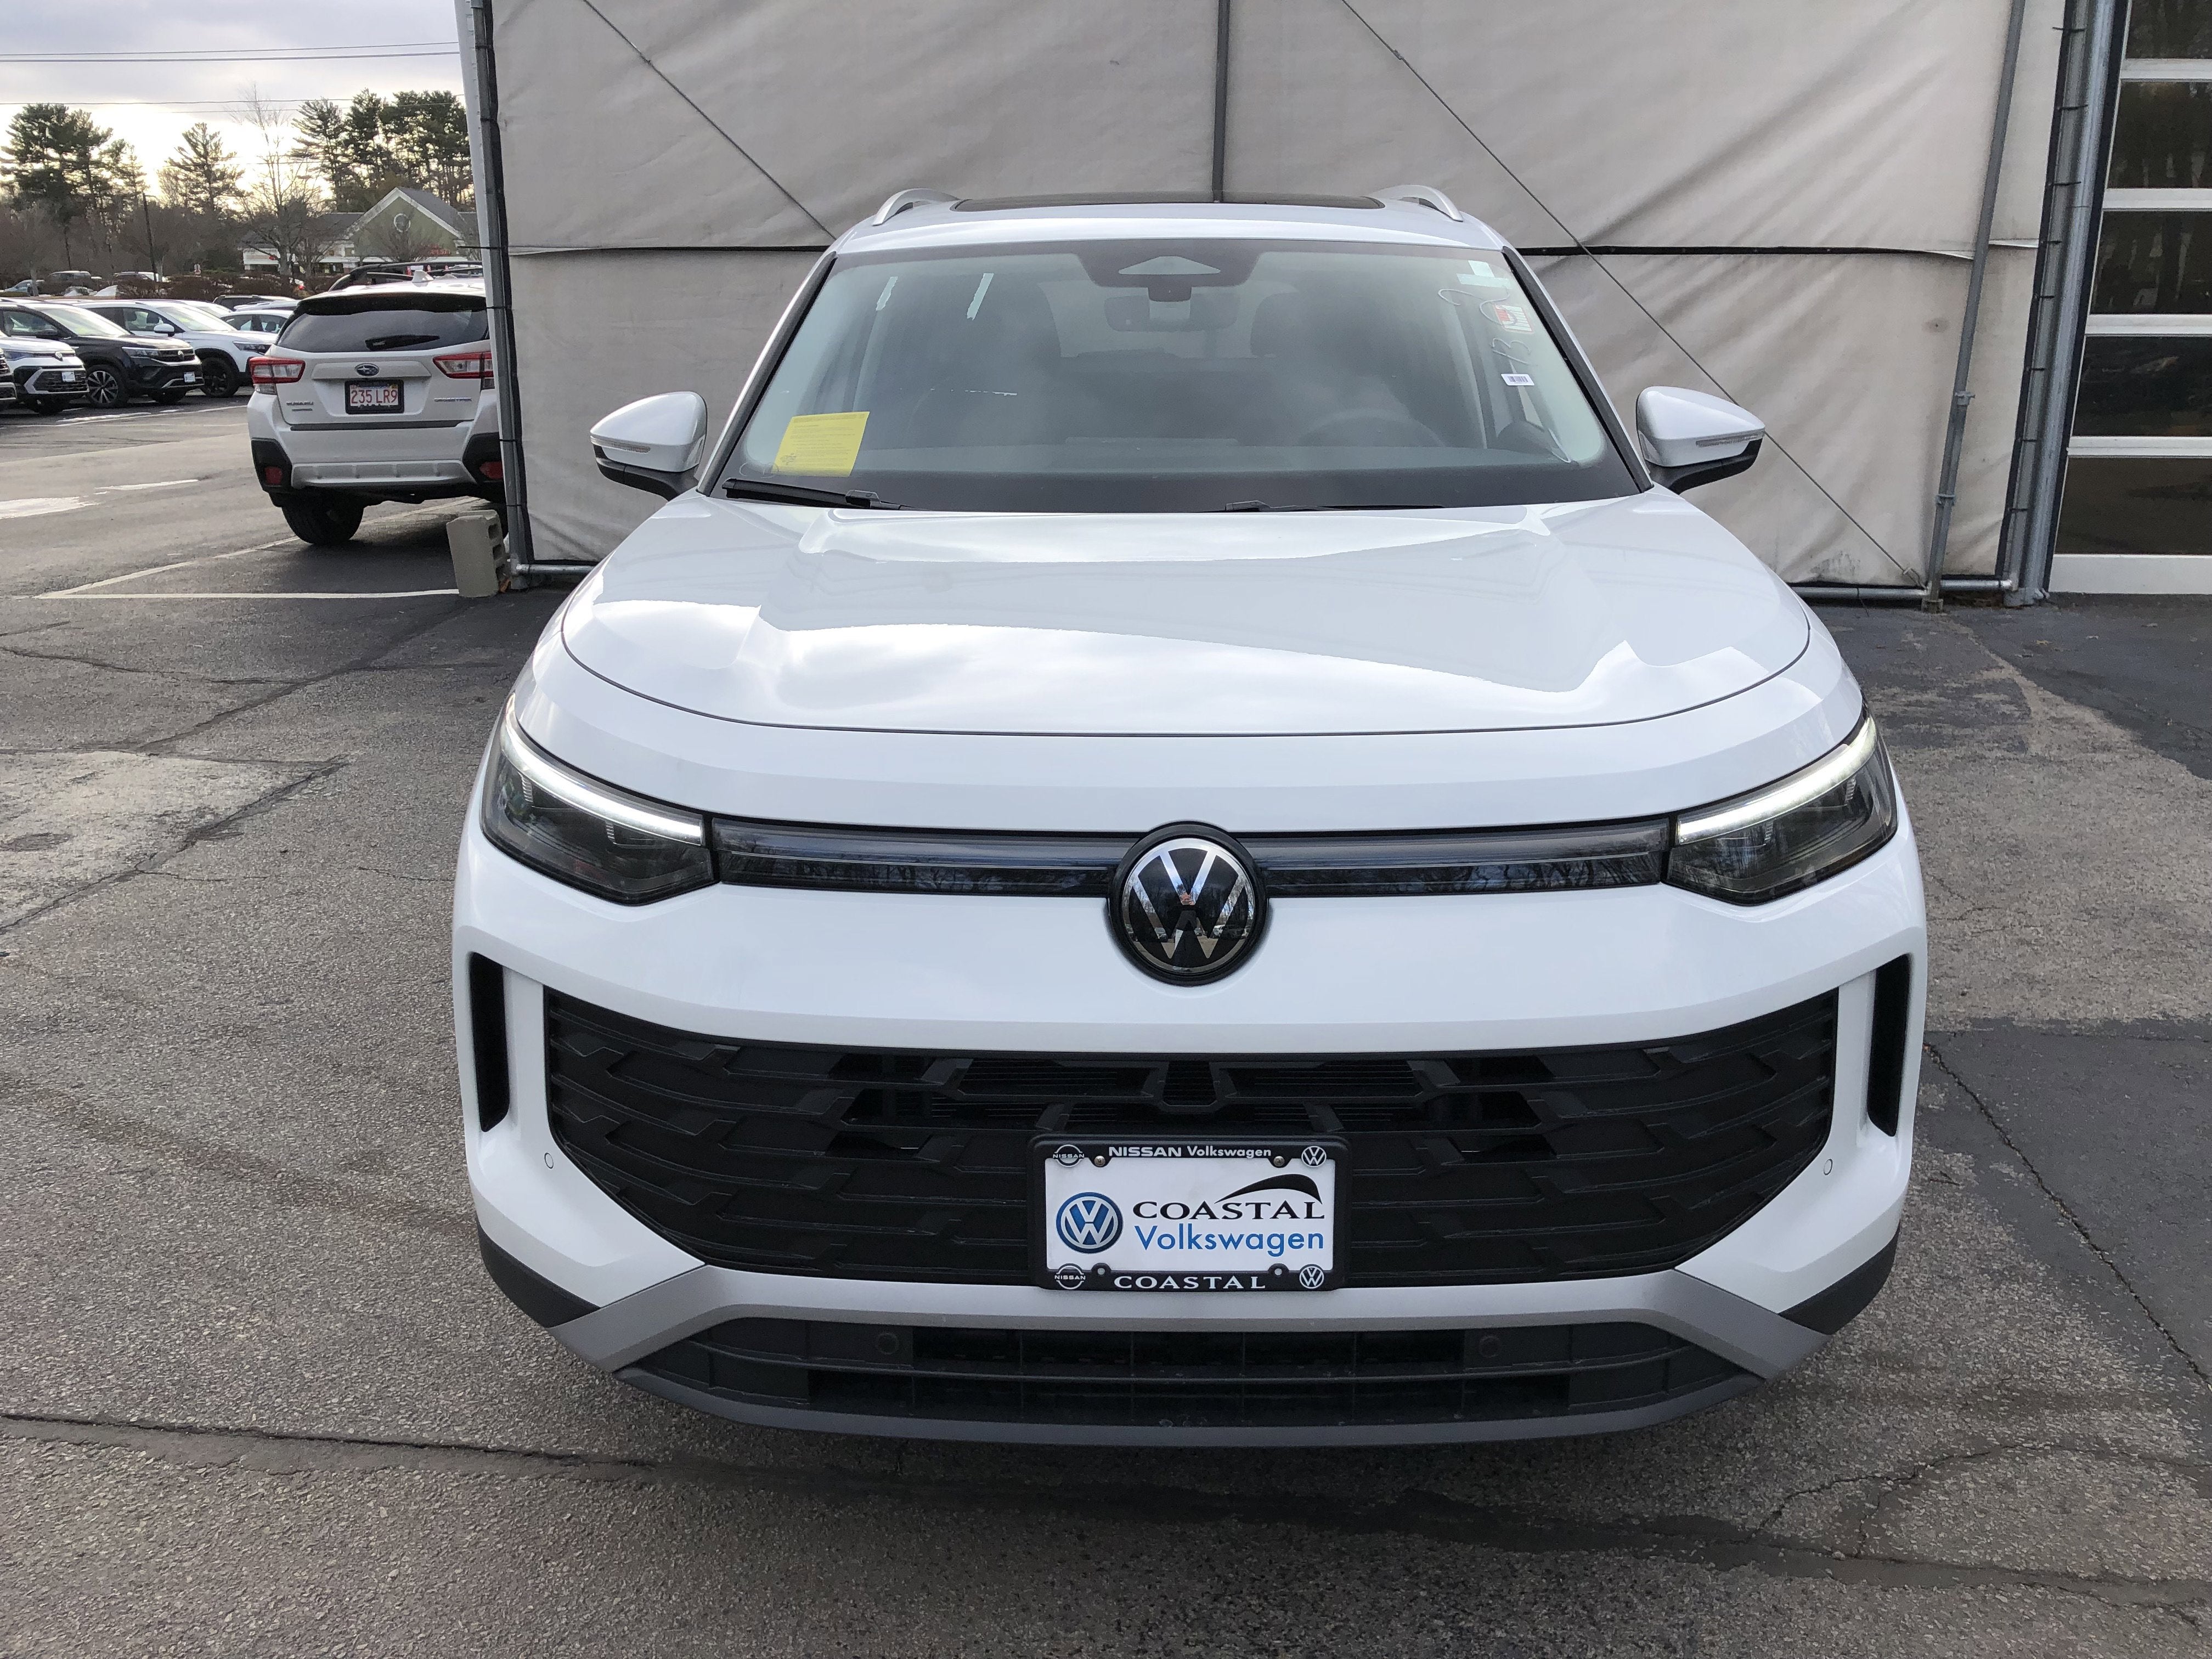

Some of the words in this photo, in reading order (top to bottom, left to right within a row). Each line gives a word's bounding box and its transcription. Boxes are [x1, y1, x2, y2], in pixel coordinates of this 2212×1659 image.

[351, 389, 373, 404] 235
[376, 388, 397, 403] LR9
[1109, 1146, 1182, 1157] NISSAN
[1187, 1145, 1272, 1159] Volkswagen
[1132, 1200, 1325, 1220] COASTAL
[1134, 1223, 1324, 1257] Volkswagen
[1114, 1275, 1266, 1289] COASTAL
